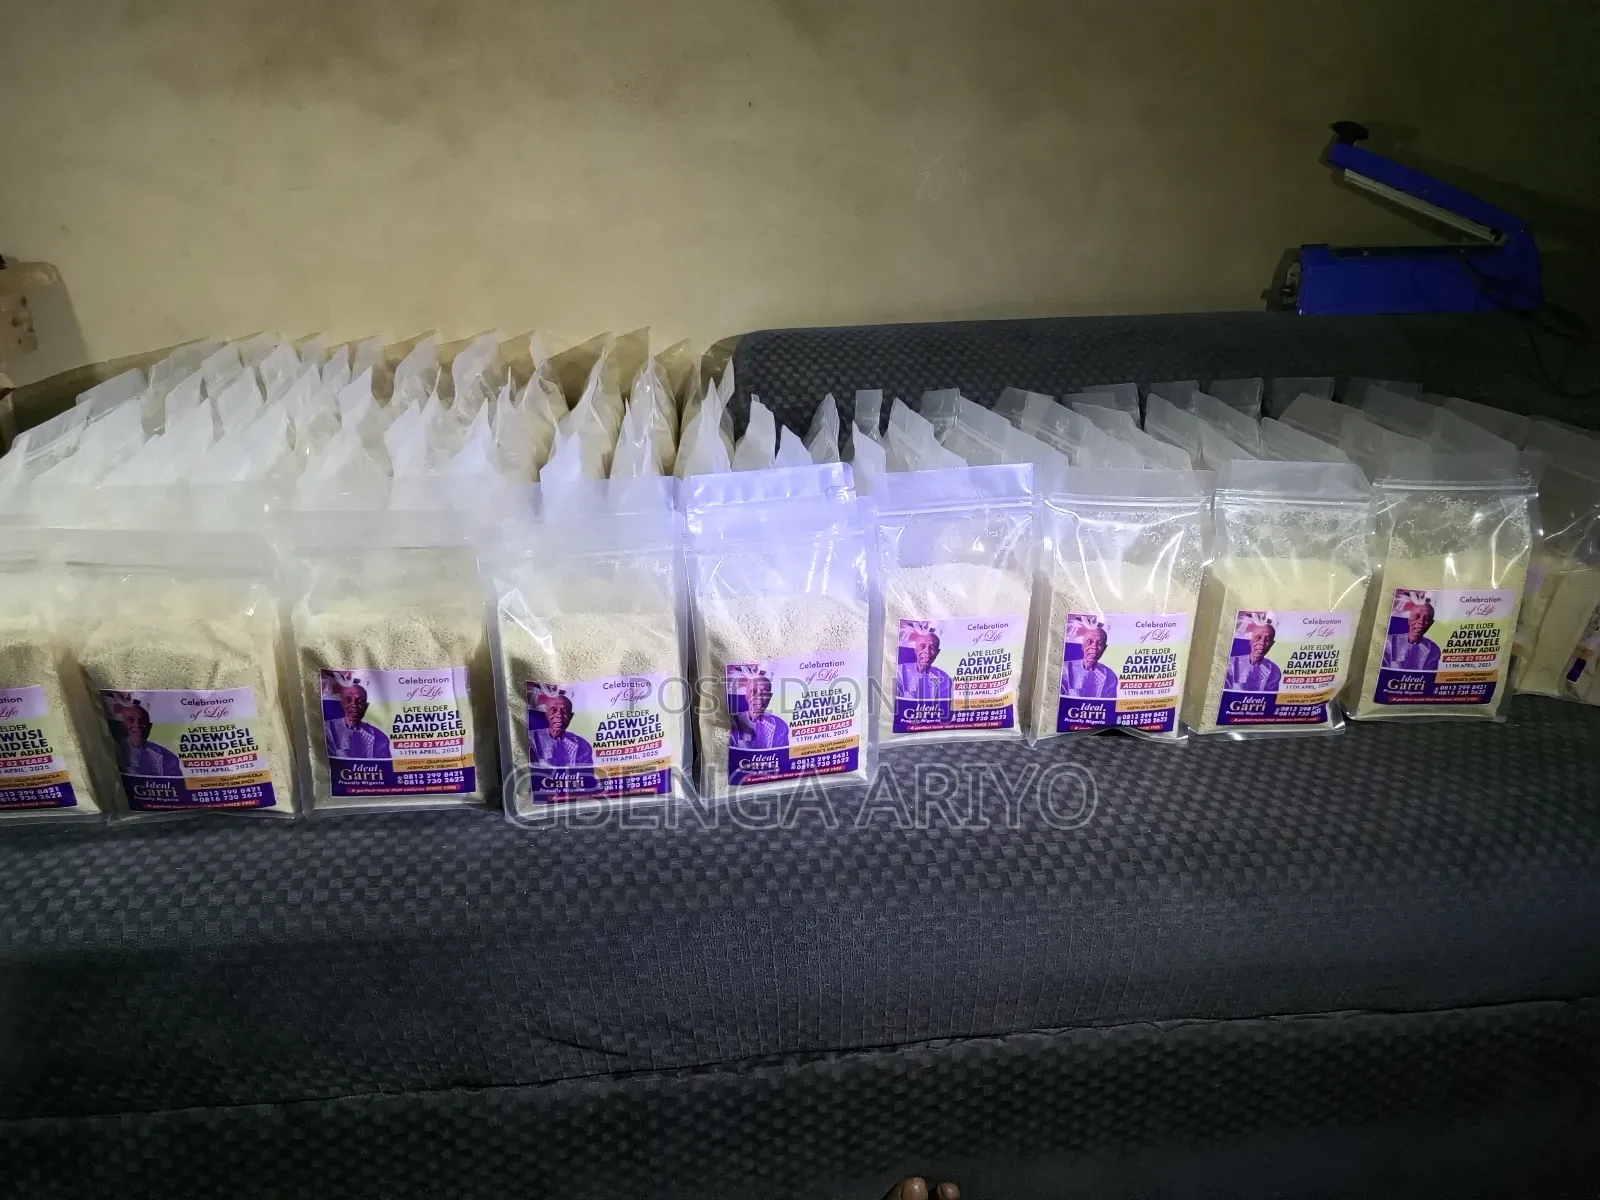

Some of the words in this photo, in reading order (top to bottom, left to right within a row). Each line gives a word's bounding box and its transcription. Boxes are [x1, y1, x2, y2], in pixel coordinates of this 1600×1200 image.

[1466, 607, 1476, 617] of
[1476, 604, 1495, 617] Life
[968, 622, 1008, 630] Celebration
[973, 633, 983, 646] of
[982, 630, 1002, 644] Life
[1140, 631, 1152, 643] of
[1150, 629, 1170, 643] Life
[1450, 629, 1500, 639] ADEWUSI
[1447, 638, 1499, 647] BAMIDELE
[800, 660, 844, 669] Celebration
[959, 653, 1010, 666] ADEWUSI
[1125, 654, 1176, 664] ADEWUSI
[957, 662, 1011, 675] BAMIDELE
[1123, 663, 1176, 673] BAMIDELE
[806, 672, 817, 685] of
[816, 669, 838, 684] Life
[953, 674, 990, 682] MATTHEW
[992, 670, 1012, 679] ADELU
[1401, 674, 1423, 682] Ideal
[603, 681, 651, 689] Celebration
[990, 680, 1007, 688] YEARS
[1387, 679, 1425, 690] Garri
[406, 688, 419, 701] of
[419, 685, 443, 700] Life
[611, 692, 621, 706] of
[622, 689, 645, 704] Life
[820, 688, 842, 697] ELDER
[181, 698, 234, 706] Celebration
[794, 693, 850, 710] ADEWUSI
[1081, 703, 1102, 711] Ideal
[190, 710, 202, 722] of
[204, 706, 229, 720] Life
[394, 710, 459, 723] ADEWUSI
[607, 711, 624, 719] LATE
[793, 702, 852, 720] BAMIDELE
[904, 708, 940, 719] Garri
[1068, 708, 1106, 719] Garri
[598, 714, 659, 731] ADEWUSI
[789, 717, 828, 727] MATTHEW
[831, 710, 854, 721] ADELU
[211, 724, 236, 732] ELDER
[393, 720, 462, 733] BAMIDELE
[828, 721, 850, 730] YEARS
[0, 729, 43, 740] WUSI
[180, 728, 250, 743] ADEWUSI
[437, 729, 465, 738] ADELU
[596, 723, 661, 741] BAMIDELE
[0, 739, 48, 751] IDELE
[180, 737, 254, 752] BAMIDELE
[593, 739, 635, 748] MATTHEW
[638, 731, 664, 743] ADELU
[21, 747, 53, 757] ADELU
[228, 745, 258, 755] ADELU
[636, 743, 659, 752] YEARS
[21, 757, 48, 765] YEARS
[227, 755, 253, 764] YEARS
[752, 753, 775, 761] Ideal
[739, 758, 779, 769] Garri
[340, 769, 383, 780] Garri
[554, 772, 579, 780] Ideal
[542, 777, 584, 788] Garri
[134, 785, 177, 797] Garri
